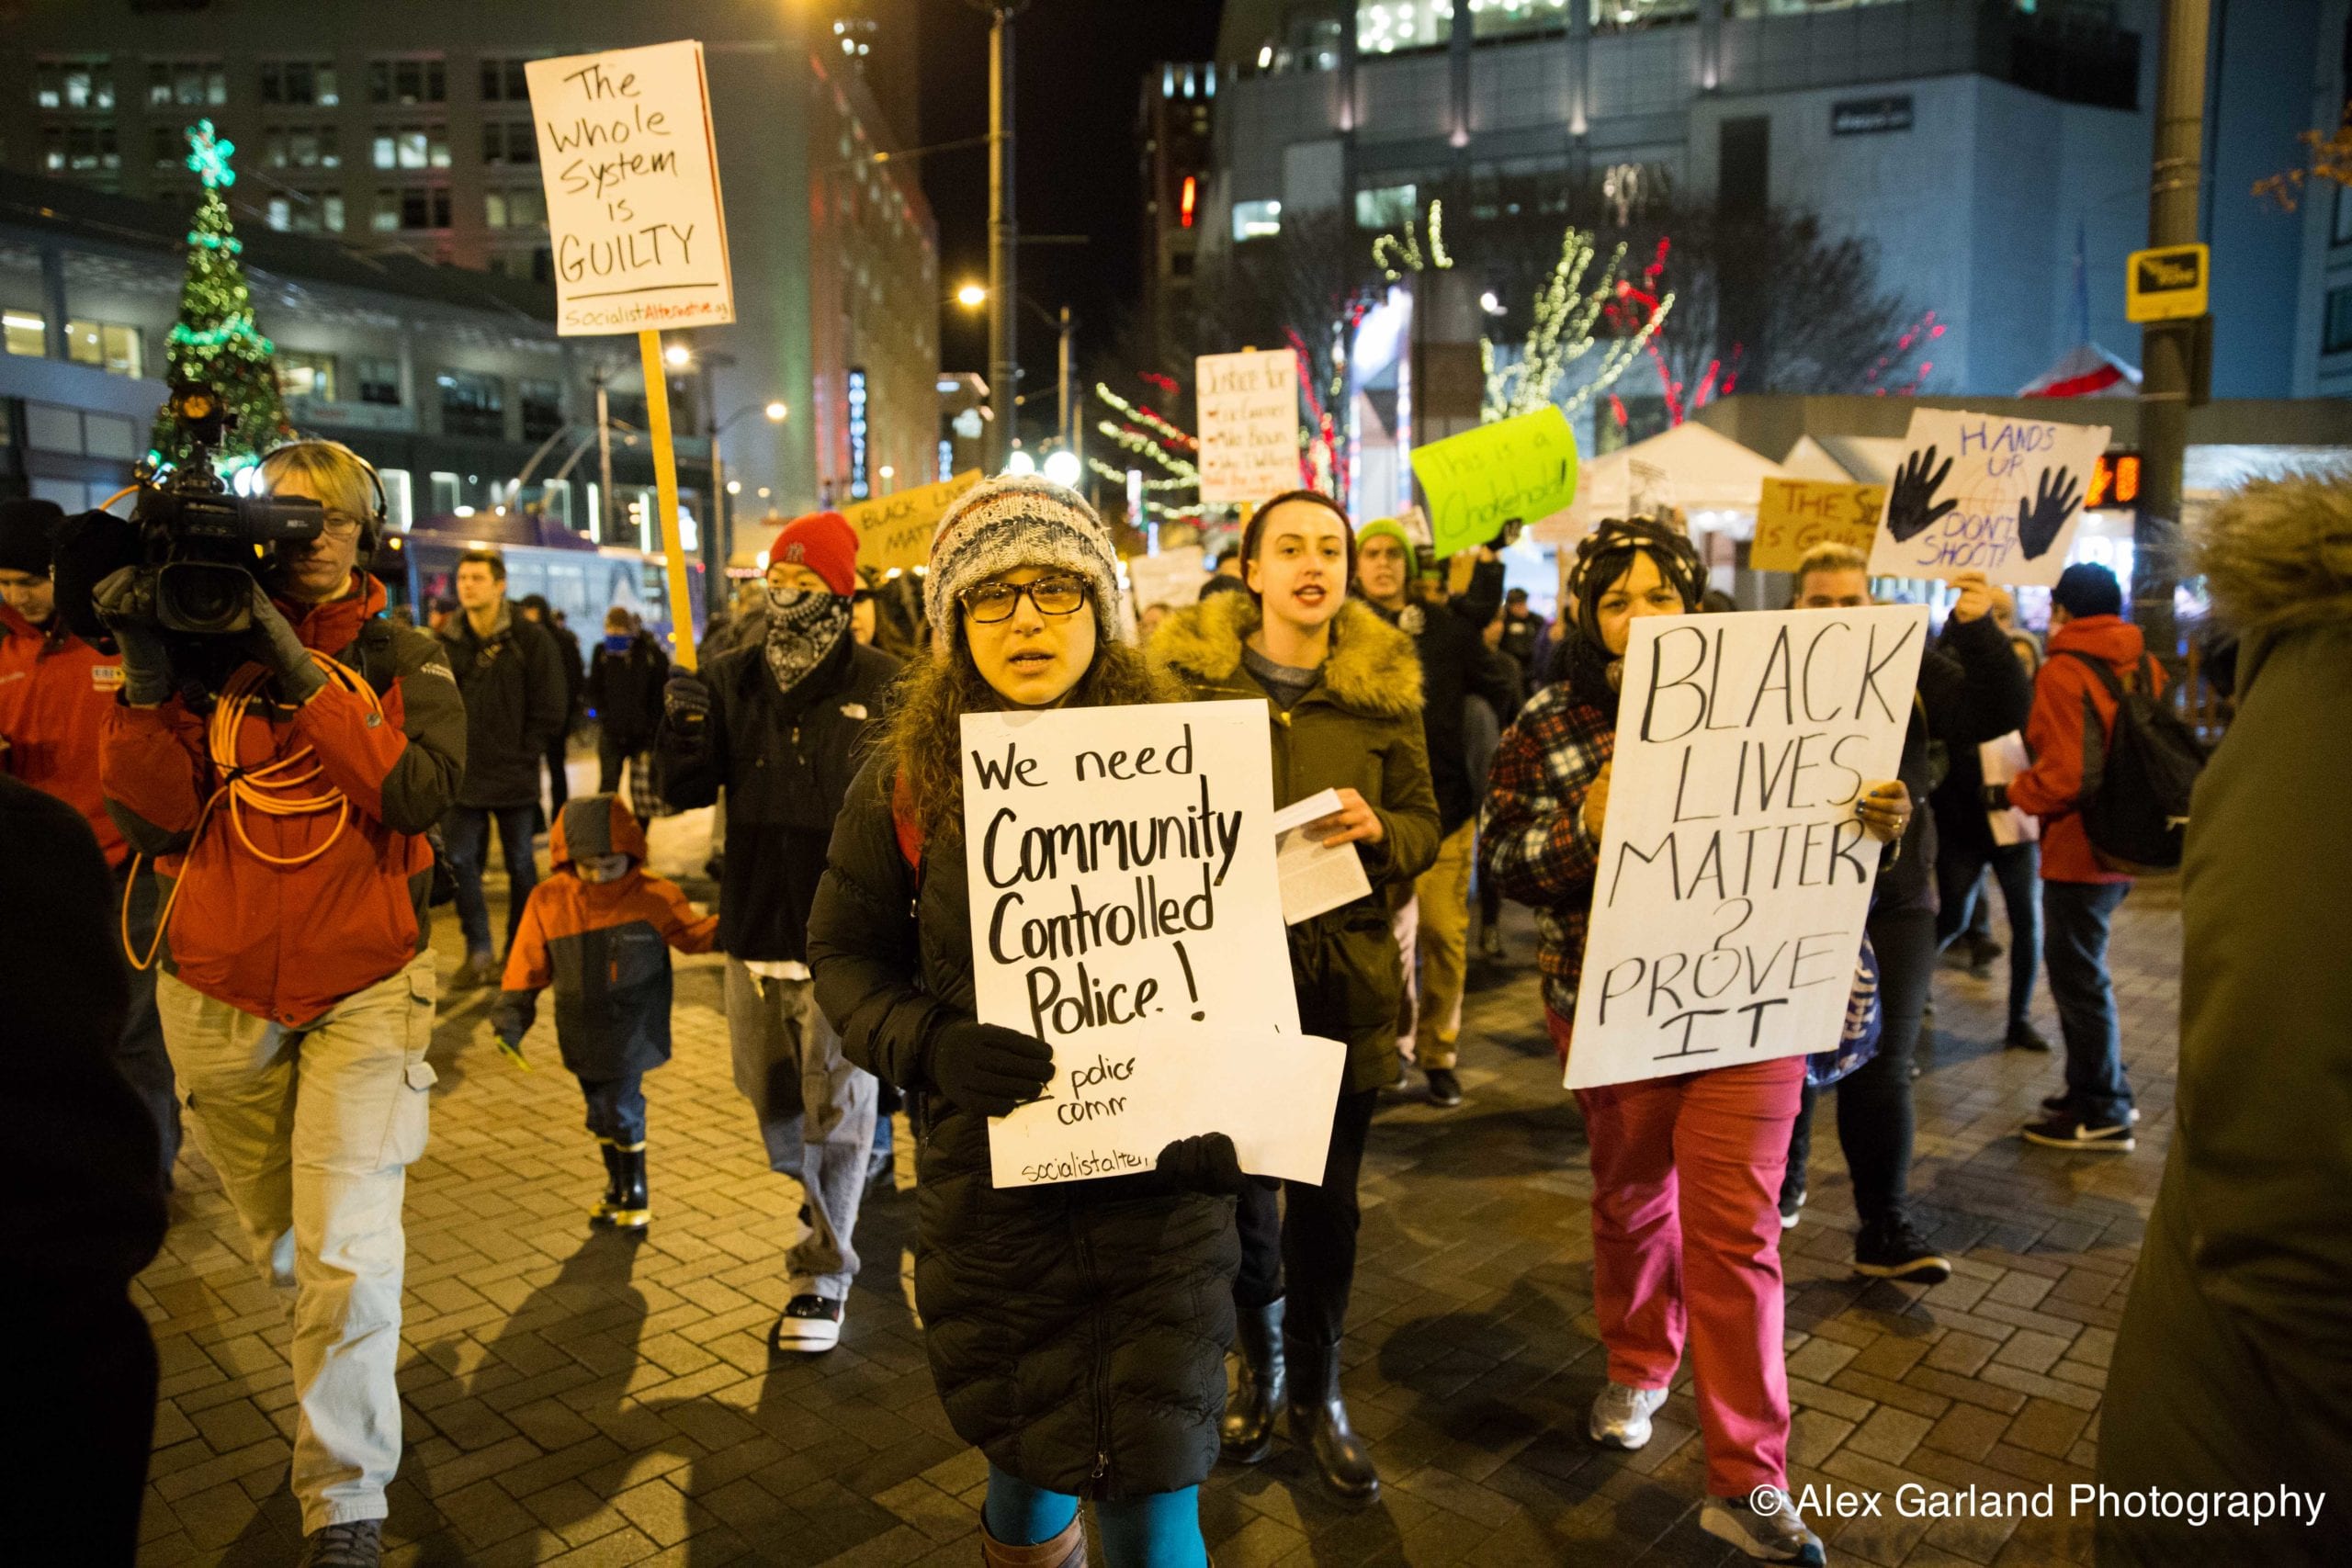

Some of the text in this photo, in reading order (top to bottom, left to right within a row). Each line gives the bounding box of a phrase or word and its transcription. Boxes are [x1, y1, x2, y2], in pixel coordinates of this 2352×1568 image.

[563, 63, 641, 101] The
[548, 104, 672, 153] Whole
[560, 150, 678, 199] System
[560, 223, 695, 283] GUILTY
[1960, 421, 2057, 457] HANDS
[1987, 457, 2024, 478] UP
[861, 499, 917, 531] BLACK
[1779, 481, 1845, 521] THE
[1758, 523, 1785, 548] IS
[1640, 620, 1918, 744] BLACK
[971, 723, 1193, 790] We need
[1672, 732, 1870, 823] LIVES
[983, 773, 1243, 888] Community
[1608, 817, 1867, 908] MATTER
[989, 861, 1215, 965] Controlled
[1713, 897, 1753, 962] ?
[1600, 931, 1850, 1027] PROVE
[1652, 998, 1789, 1061] IT
